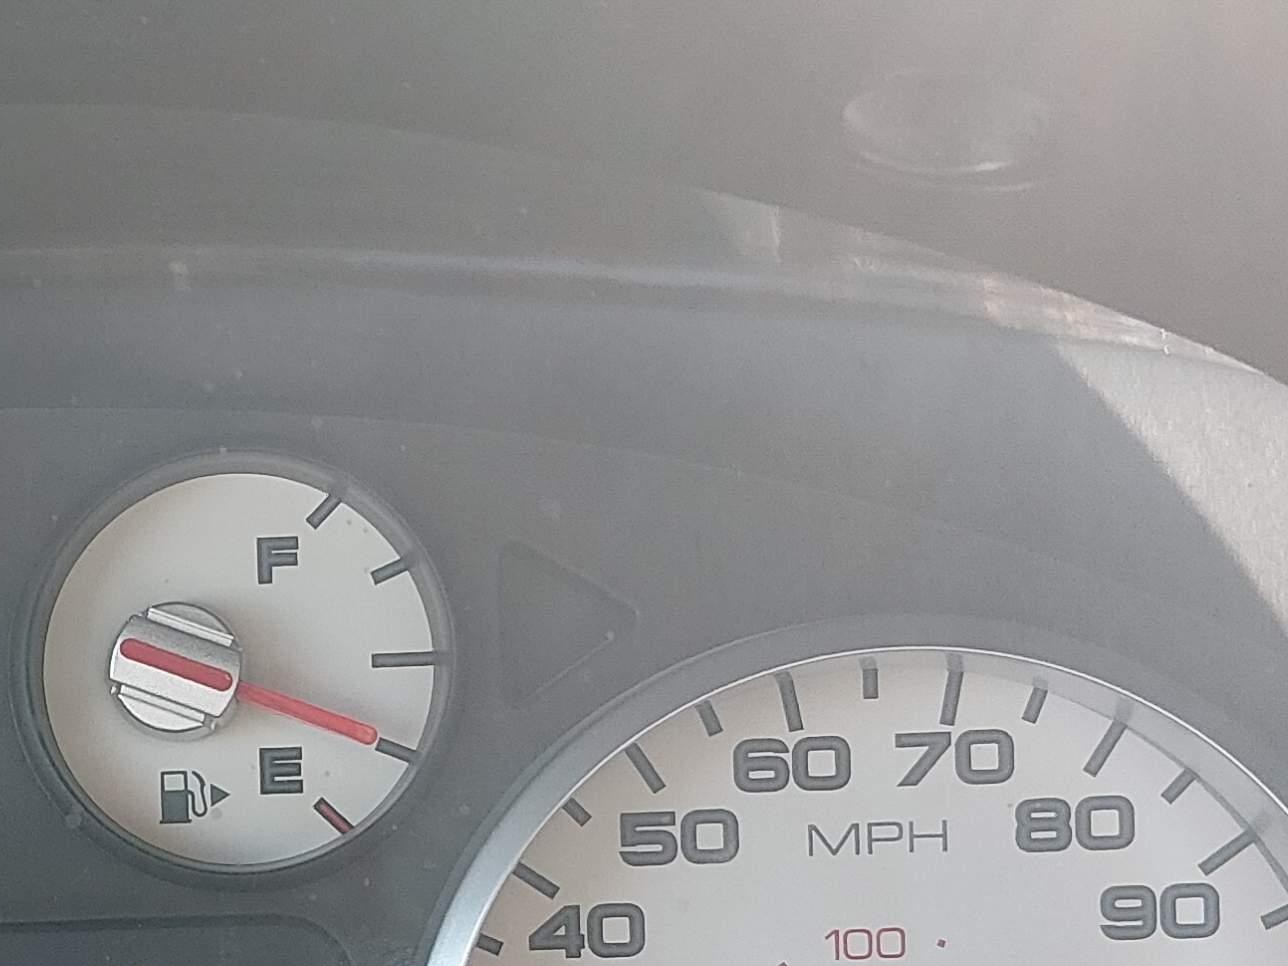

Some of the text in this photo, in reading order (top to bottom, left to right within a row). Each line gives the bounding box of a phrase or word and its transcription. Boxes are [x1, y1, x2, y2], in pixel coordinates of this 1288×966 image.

[256, 537, 298, 584] F
[259, 747, 303, 795] E
[732, 737, 852, 793] 60
[894, 729, 1015, 787] 70
[619, 808, 739, 867] 50
[807, 819, 949, 857] MPH
[1015, 796, 1135, 852] 80
[528, 903, 646, 959] 40
[1099, 882, 1220, 941] 90
[824, 927, 906, 961] 100
